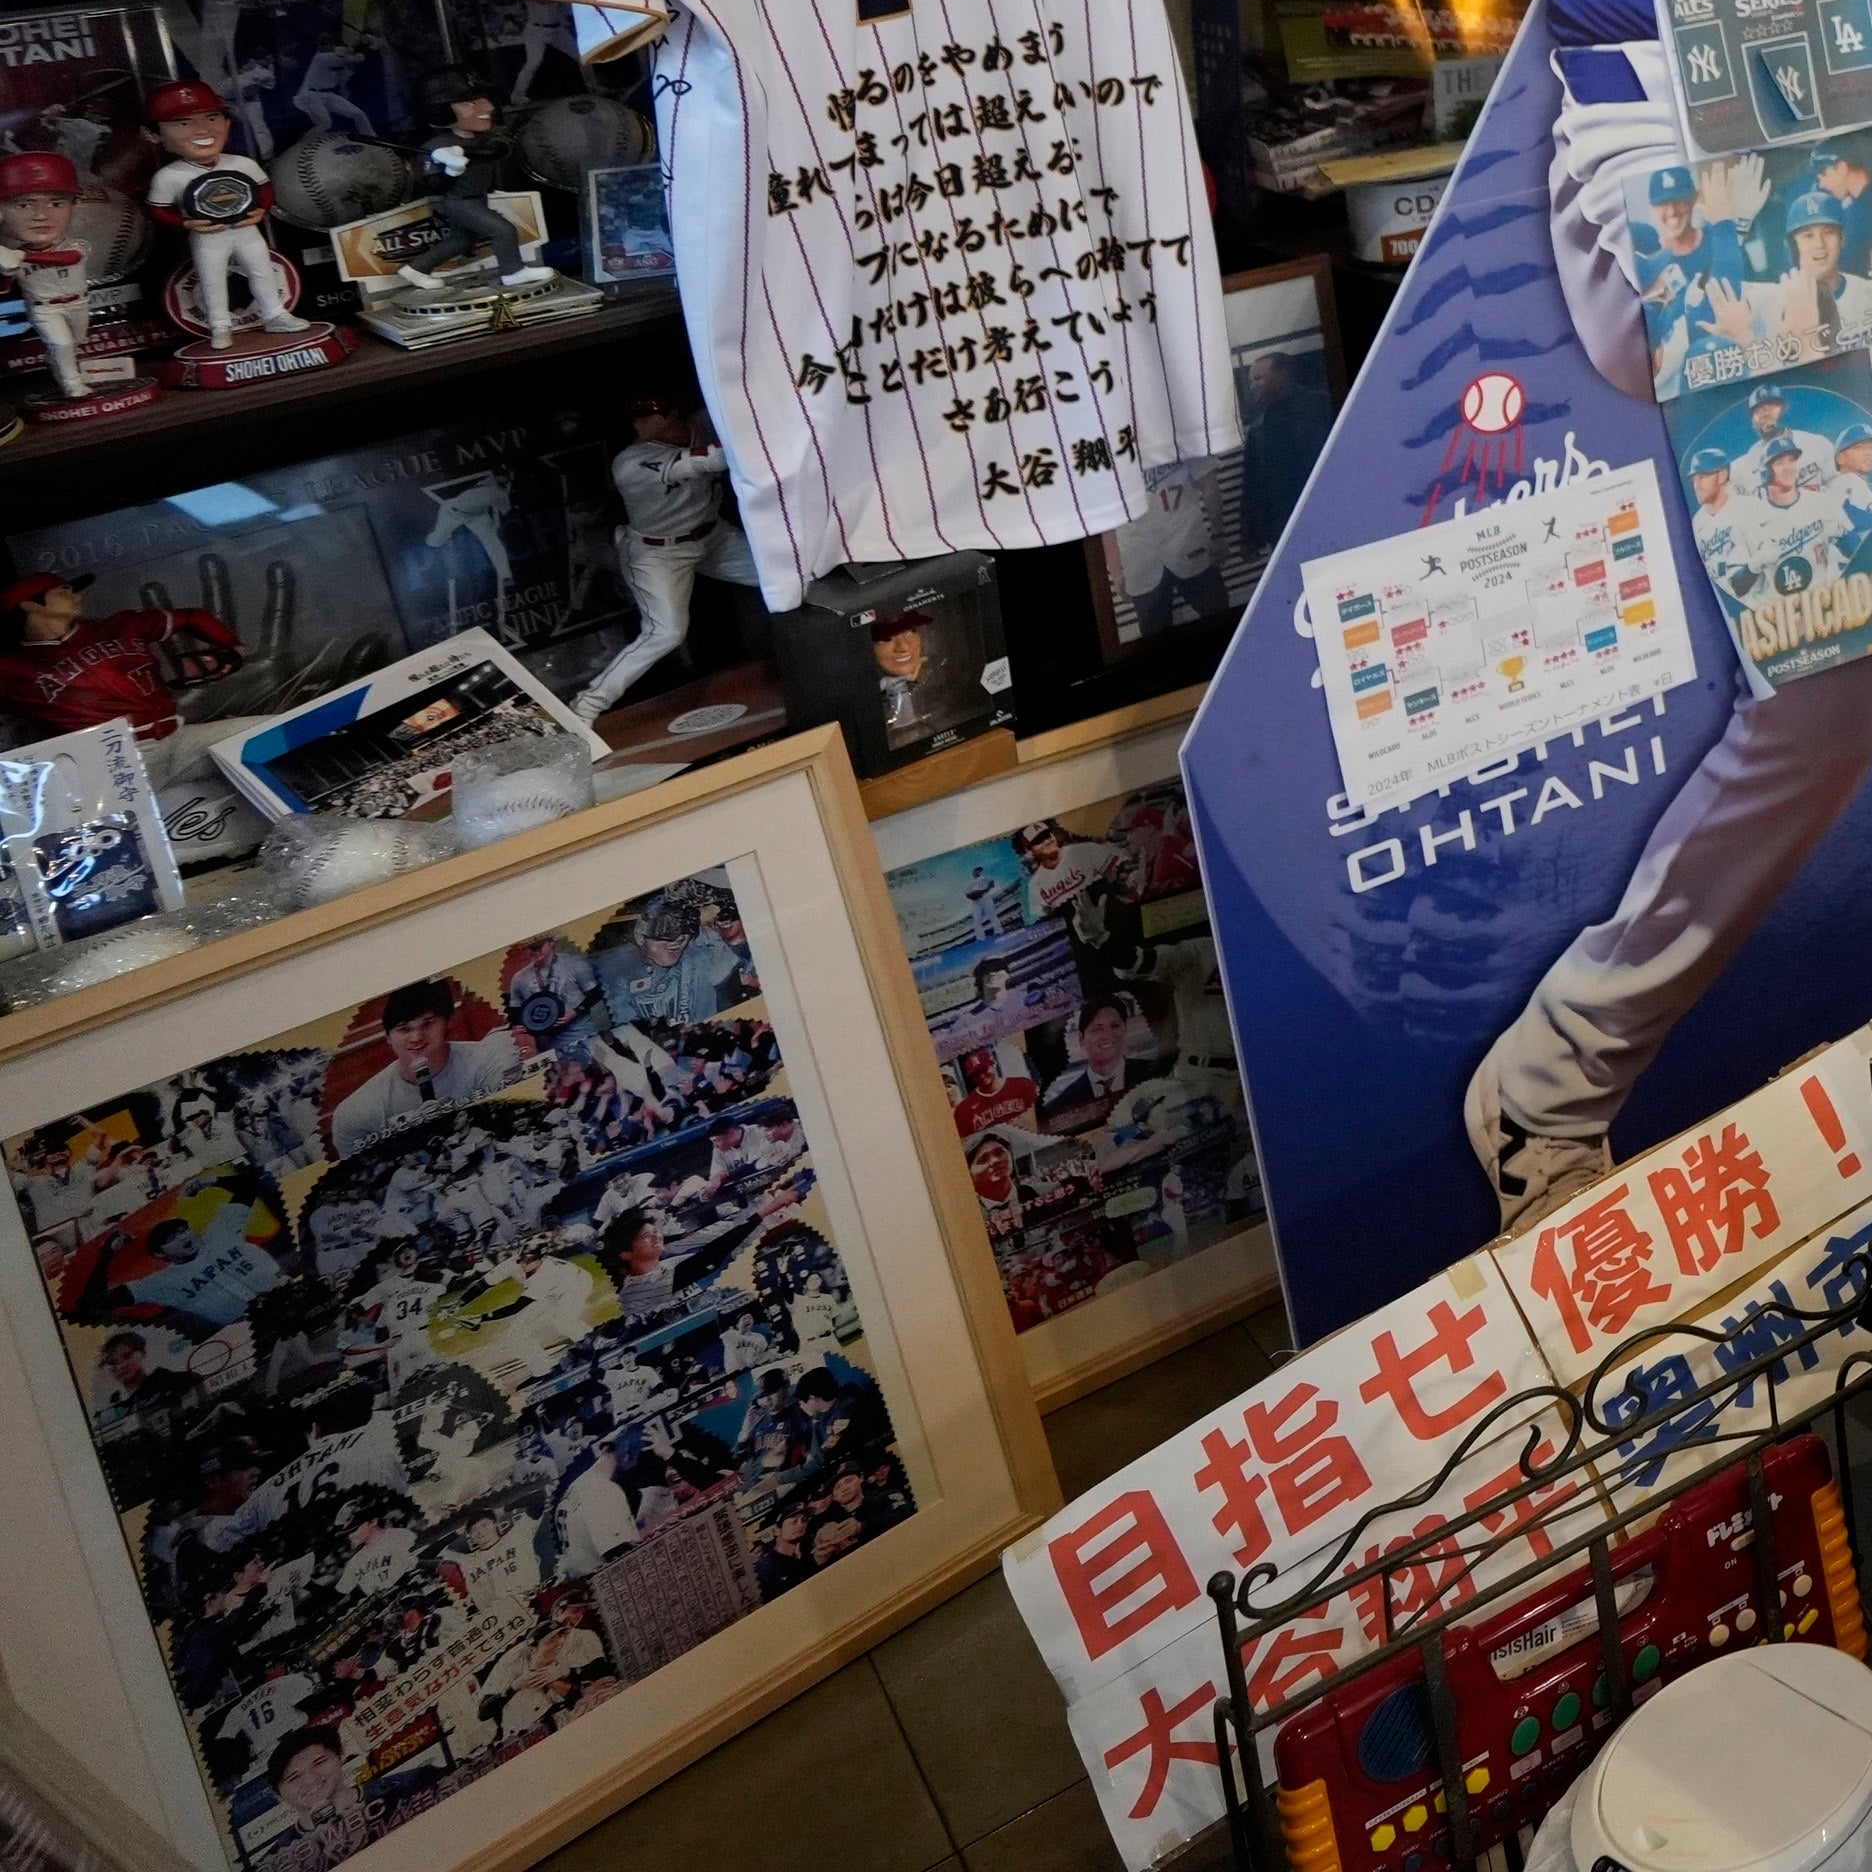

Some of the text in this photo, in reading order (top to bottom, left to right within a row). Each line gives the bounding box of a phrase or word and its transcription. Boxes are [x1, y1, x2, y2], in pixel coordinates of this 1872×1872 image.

[1831, 14, 1864, 54] LA
[1687, 44, 1722, 85] NY
[224, 344, 330, 384] SHOHEI OHTANI
[1476, 525, 1501, 541] MLB
[1459, 542, 1528, 573] POSTSEASON
[1483, 570, 1514, 589] 2024
[1783, 567, 1803, 591] LA
[34, 635, 150, 702] ANGELS
[126, 659, 157, 697] 17
[1766, 643, 1842, 679] POSTSEASON
[1366, 684, 1641, 796] 2024年 MLBポストシーズントーナメント表
[1345, 736, 1667, 895] OHTANI
[1039, 867, 1088, 903] Angels
[179, 1245, 243, 1299] JAPAN
[396, 1297, 422, 1322] 34
[1045, 1074, 1861, 1663] 目指せ優勝！
[1723, 1558, 1739, 1571] ON
